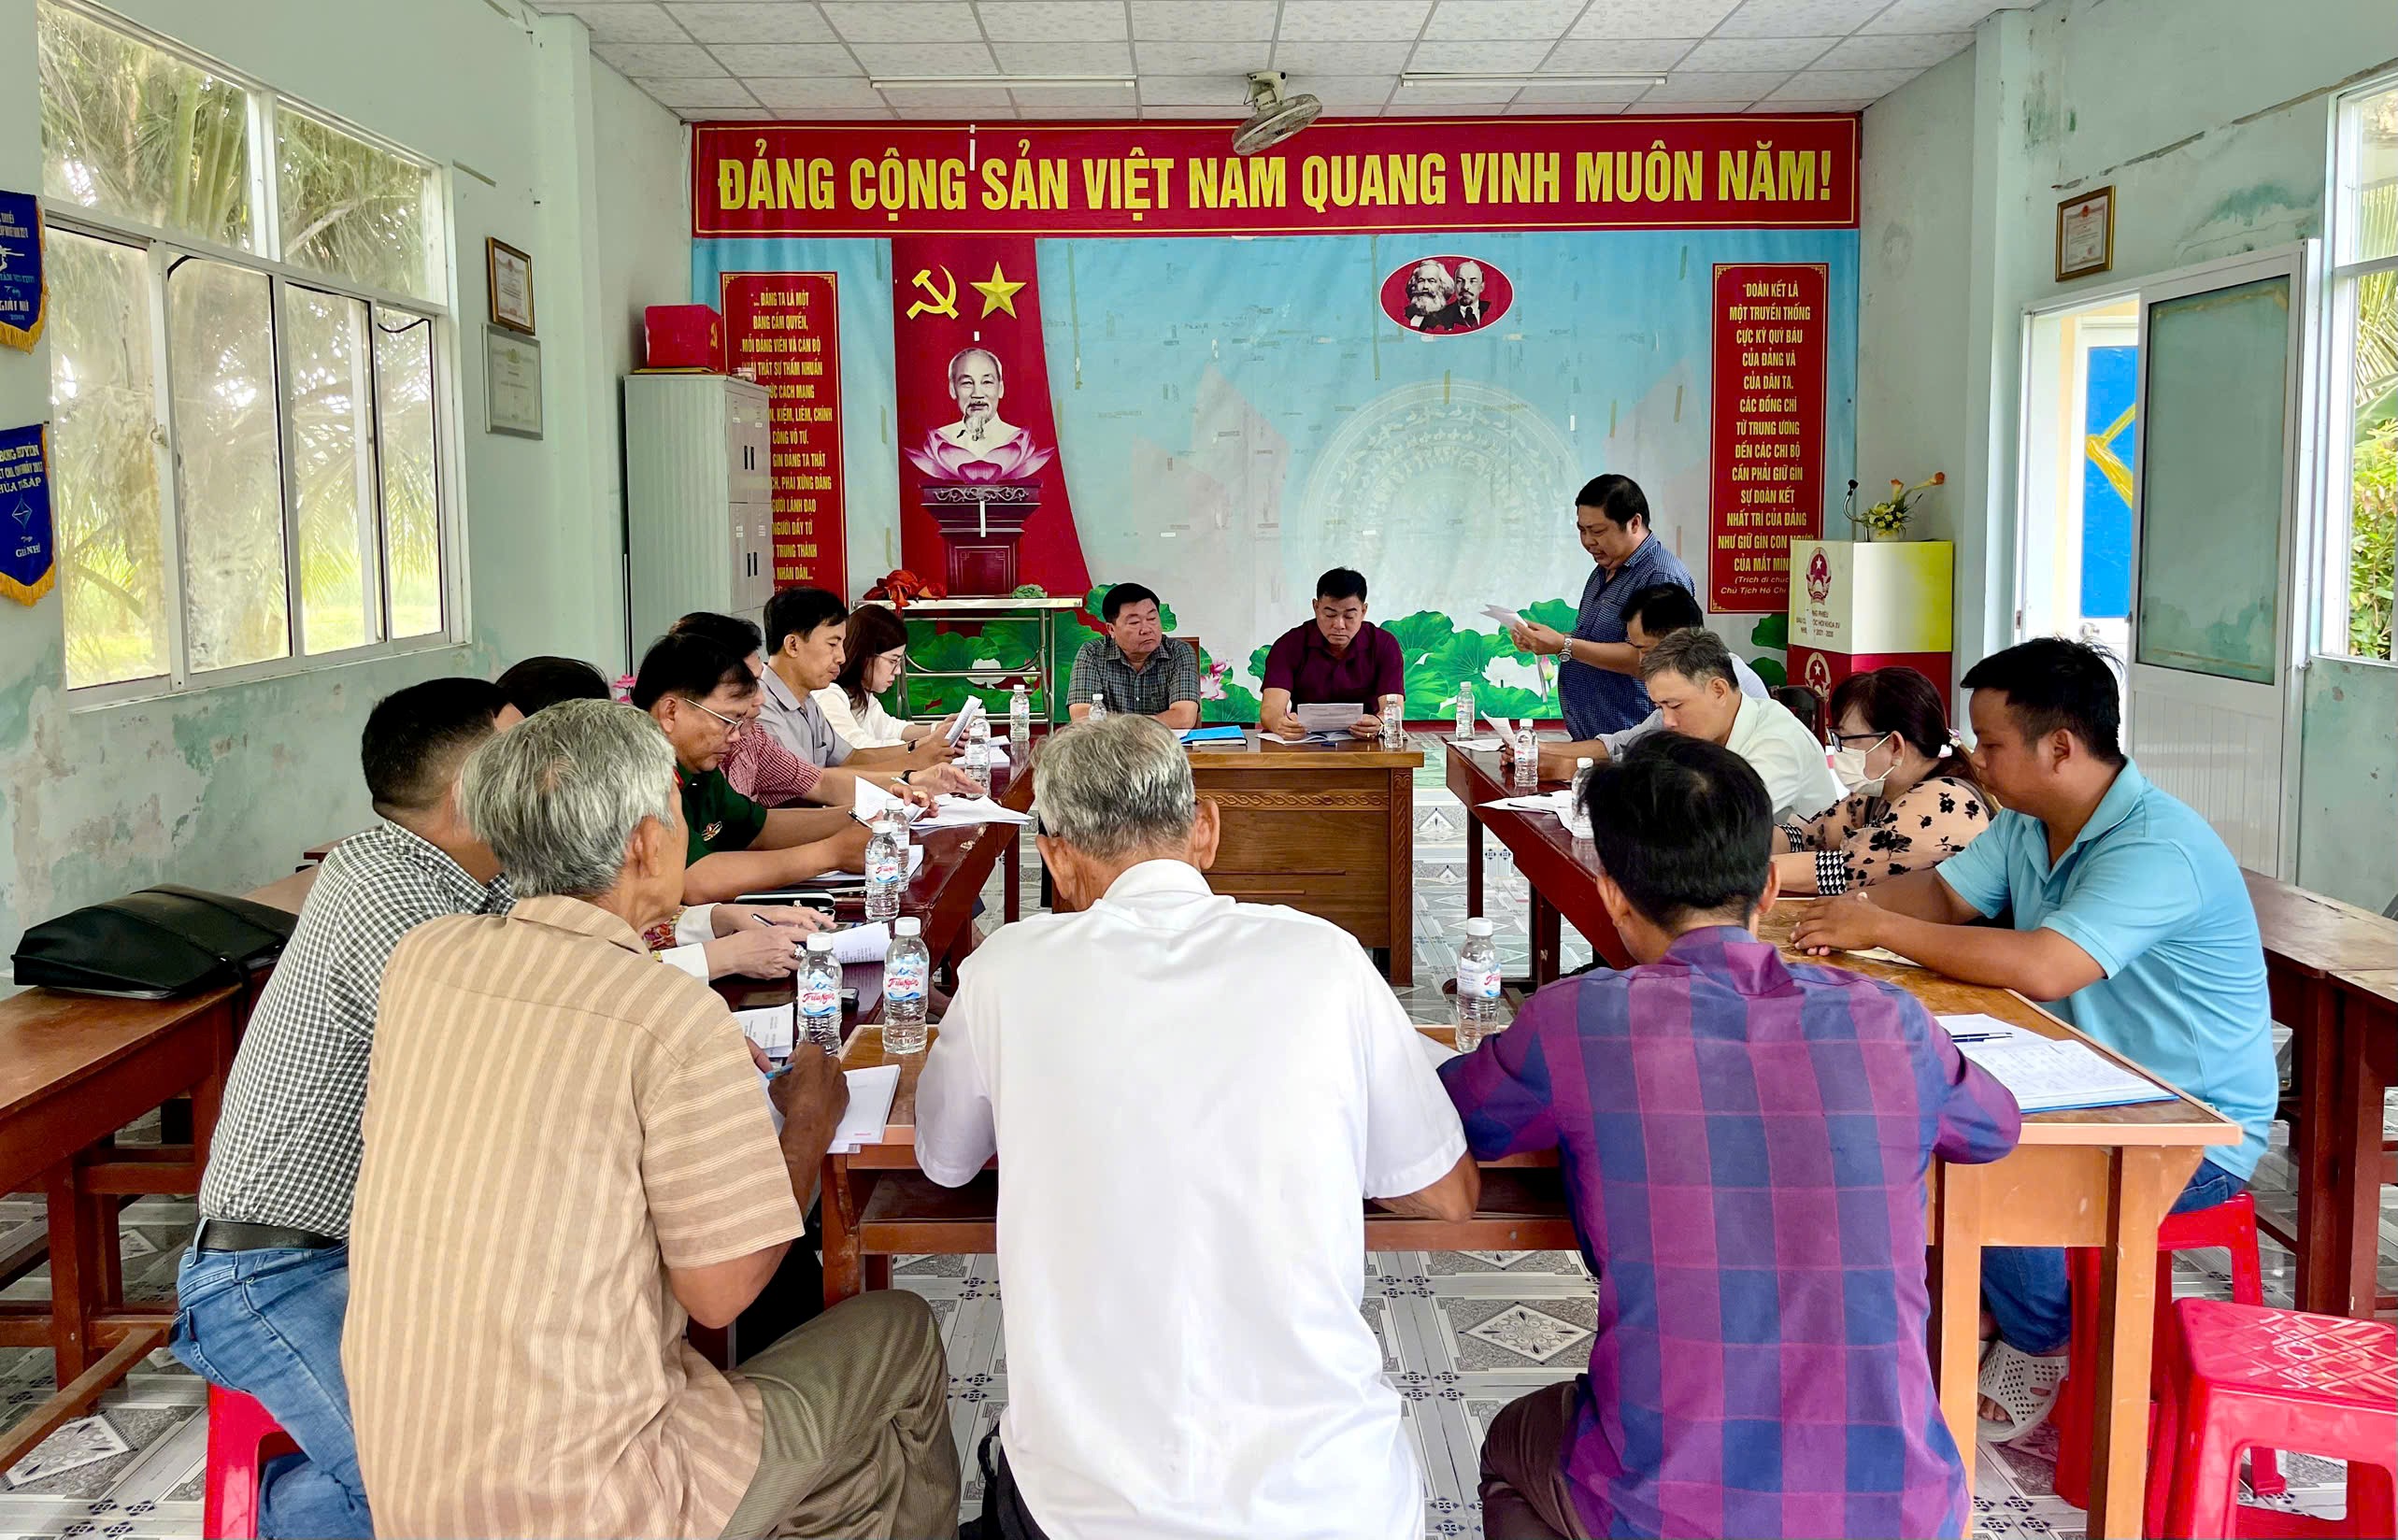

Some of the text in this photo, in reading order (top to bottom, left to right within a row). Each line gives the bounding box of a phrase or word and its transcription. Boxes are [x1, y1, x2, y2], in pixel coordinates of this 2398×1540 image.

[718, 139, 1831, 221] ĐẢNG CỘNG SẢN VIỆT NAM QUANG VINH MUÔN NĂM!
[1771, 279, 1786, 297] KẾT
[1788, 279, 1799, 297] LÀ
[1729, 304, 1749, 323] MỘT
[1783, 302, 1810, 321] THỐNG
[1742, 347, 1796, 366] CỦA ĐẢNG VÀ
[1744, 370, 1761, 390] CỦA
[1763, 373, 1780, 390] DÂN
[1740, 395, 1757, 412] CÁC
[1784, 396, 1797, 412] CHÍ
[1735, 440, 1801, 461] ĐẾN CÁC CHI BỘ
[1741, 485, 1794, 506] SỰ ĐOÀN KẾT
[1727, 507, 1807, 526] NHẤT TRÍ CỦA ĐẢNG
[1718, 534, 1736, 549] NHƯ
[1737, 533, 1753, 549] GIỮ
[1754, 533, 1768, 549] GÌN
[1770, 535, 1788, 549] CON
